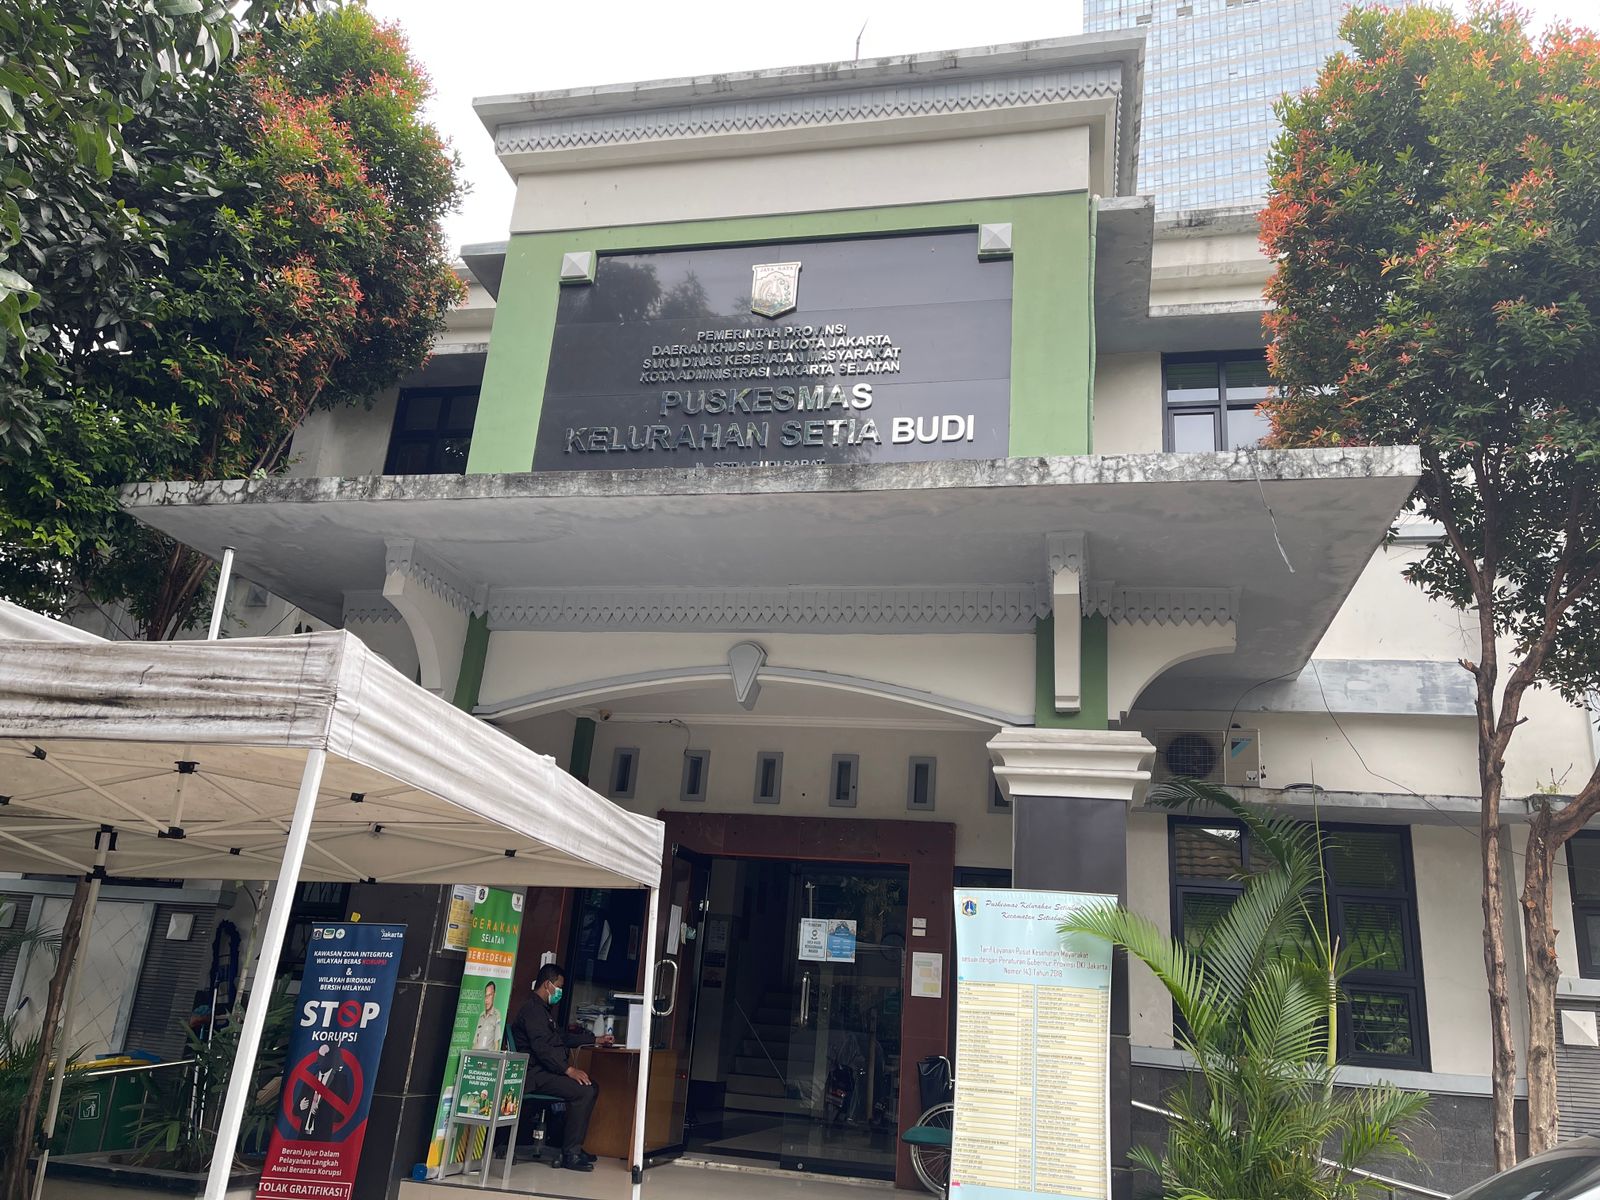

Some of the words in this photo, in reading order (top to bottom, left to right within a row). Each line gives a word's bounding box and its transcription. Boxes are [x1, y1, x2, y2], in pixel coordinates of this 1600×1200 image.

[697, 327, 781, 341] PEMERINTAH
[784, 324, 847, 337] PROVINSI
[652, 343, 707, 356] DAERAH
[710, 341, 764, 352] KHUSUS
[768, 338, 826, 350] IBUKOTA
[830, 335, 892, 348] JAKARTA
[642, 358, 679, 369] SUKU
[682, 355, 722, 367] DINAS
[725, 352, 803, 365] KESEHATAN
[806, 347, 901, 362] MASYARAKAT
[640, 371, 675, 382] KOTA
[677, 367, 770, 380] ADMINISTRASI
[773, 363, 835, 377] JAKARTA
[839, 360, 901, 375] SELATAN
[659, 382, 873, 416] PUSKESMAS
[564, 421, 769, 454] KELURAHAN
[779, 418, 882, 447] SETIA
[892, 414, 975, 444] BUDI
[985, 900, 1018, 909] Puskesmas
[1020, 901, 1052, 910] Kelurahan
[1001, 912, 1035, 920] Kecamatan
[472, 917, 519, 935] GERAKAN
[481, 933, 504, 944] SELATAN
[468, 951, 512, 964] BERSEDEKAH
[1087, 962, 1108, 970] Jakarta
[300, 1000, 380, 1028] STOP
[312, 1031, 358, 1042] KORUPSI
[302, 1149, 318, 1157] Jujur
[279, 1157, 311, 1165] Pelayanan
[312, 1159, 338, 1167] Langkah
[289, 1166, 316, 1174] Berantas
[318, 1169, 341, 1177] Korupsi
[258, 1183, 288, 1192] TOLAK
[290, 1184, 342, 1196] GRATIFIKASI
